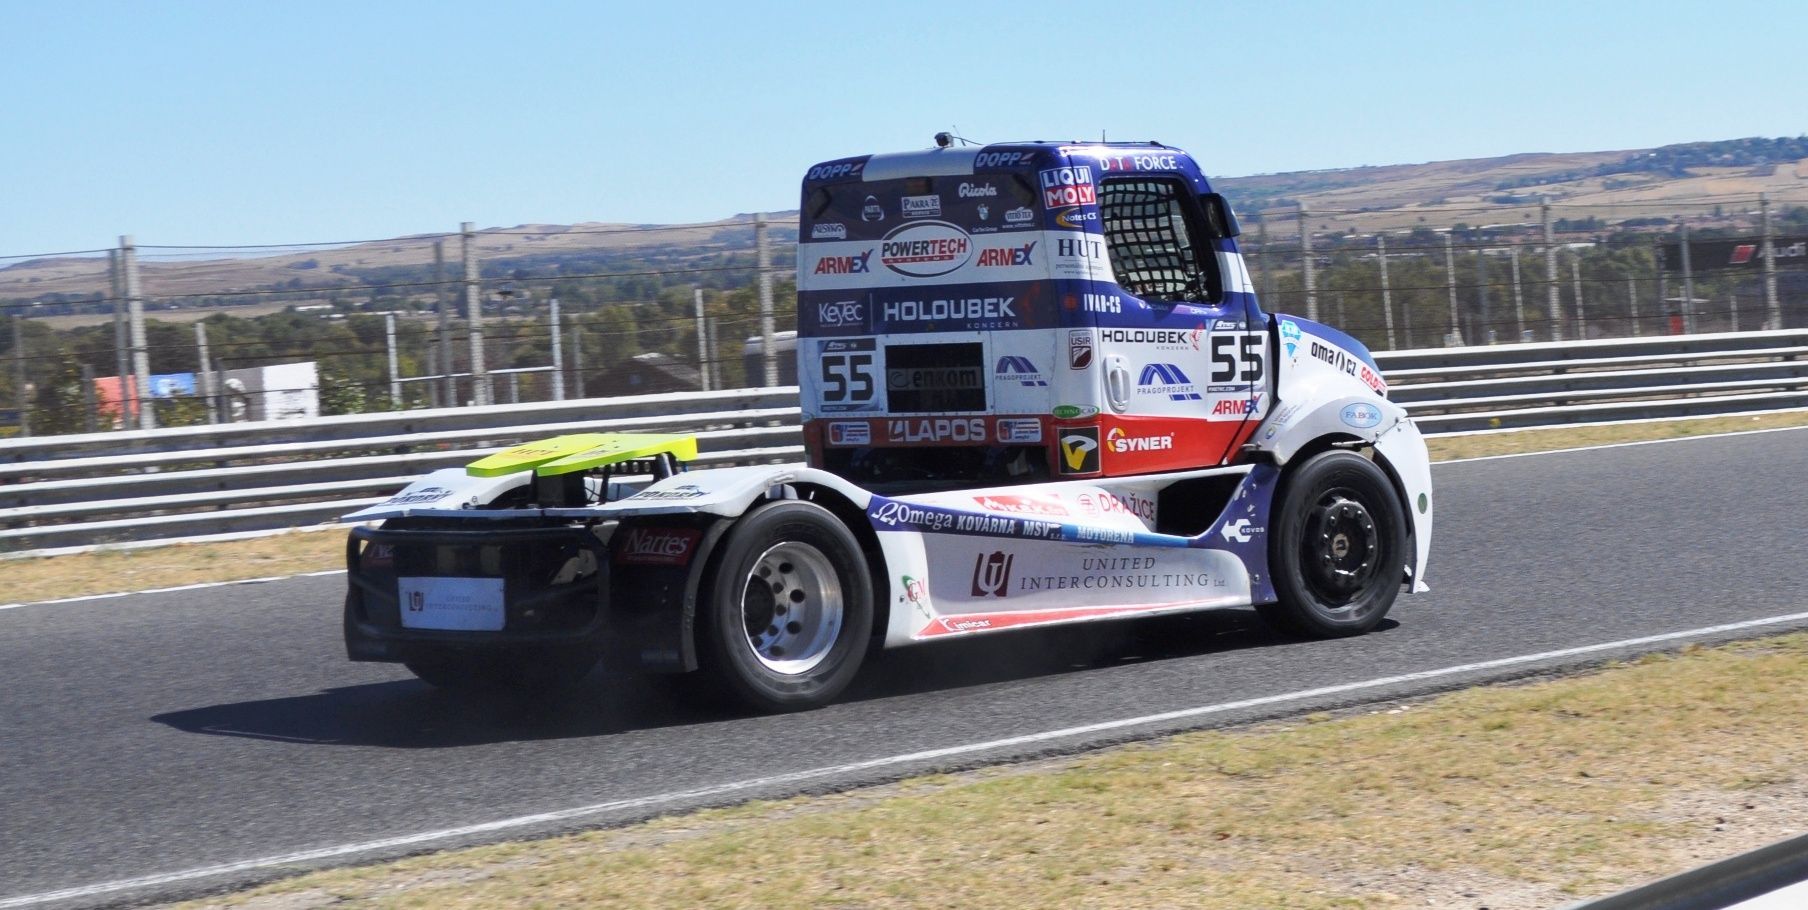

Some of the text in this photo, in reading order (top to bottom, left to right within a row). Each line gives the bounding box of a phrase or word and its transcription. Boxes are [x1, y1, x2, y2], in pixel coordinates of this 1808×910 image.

[976, 152, 1022, 167] DOPP
[1134, 156, 1177, 170] FORCE
[809, 163, 852, 180] DOPP
[1043, 169, 1090, 187] LIQUI
[959, 182, 997, 198] Ricola
[1048, 186, 1094, 206] MOLY
[903, 198, 929, 209] PAKRA
[881, 238, 967, 257] POWERTECH
[976, 241, 1037, 267] ARMEX
[1056, 238, 1102, 258] HUT
[815, 248, 874, 275] ARMEX
[818, 301, 863, 327] KeyTec
[884, 297, 1016, 321] HOLOUBEK
[967, 321, 1019, 329] KONCERN
[1071, 336, 1091, 346] USIR
[1102, 330, 1188, 344] HOLOUBEK
[1211, 335, 1263, 382] 55
[822, 354, 874, 401] 55
[1137, 385, 1195, 395] PRAGOPROJEKT
[1212, 393, 1263, 415] ARMEX
[905, 418, 986, 442] LAPOS
[1116, 436, 1173, 452] SYNER
[1099, 492, 1154, 521] DRAŽICE
[898, 505, 952, 530] Omega
[957, 513, 1015, 534] KOVÁRNA
[1023, 520, 1050, 537] MSV
[624, 529, 690, 555] Nartes
[1077, 526, 1134, 544] MOTORENA
[1082, 557, 1156, 571] UNITED
[1021, 574, 1209, 590] INTERCONSULTING
